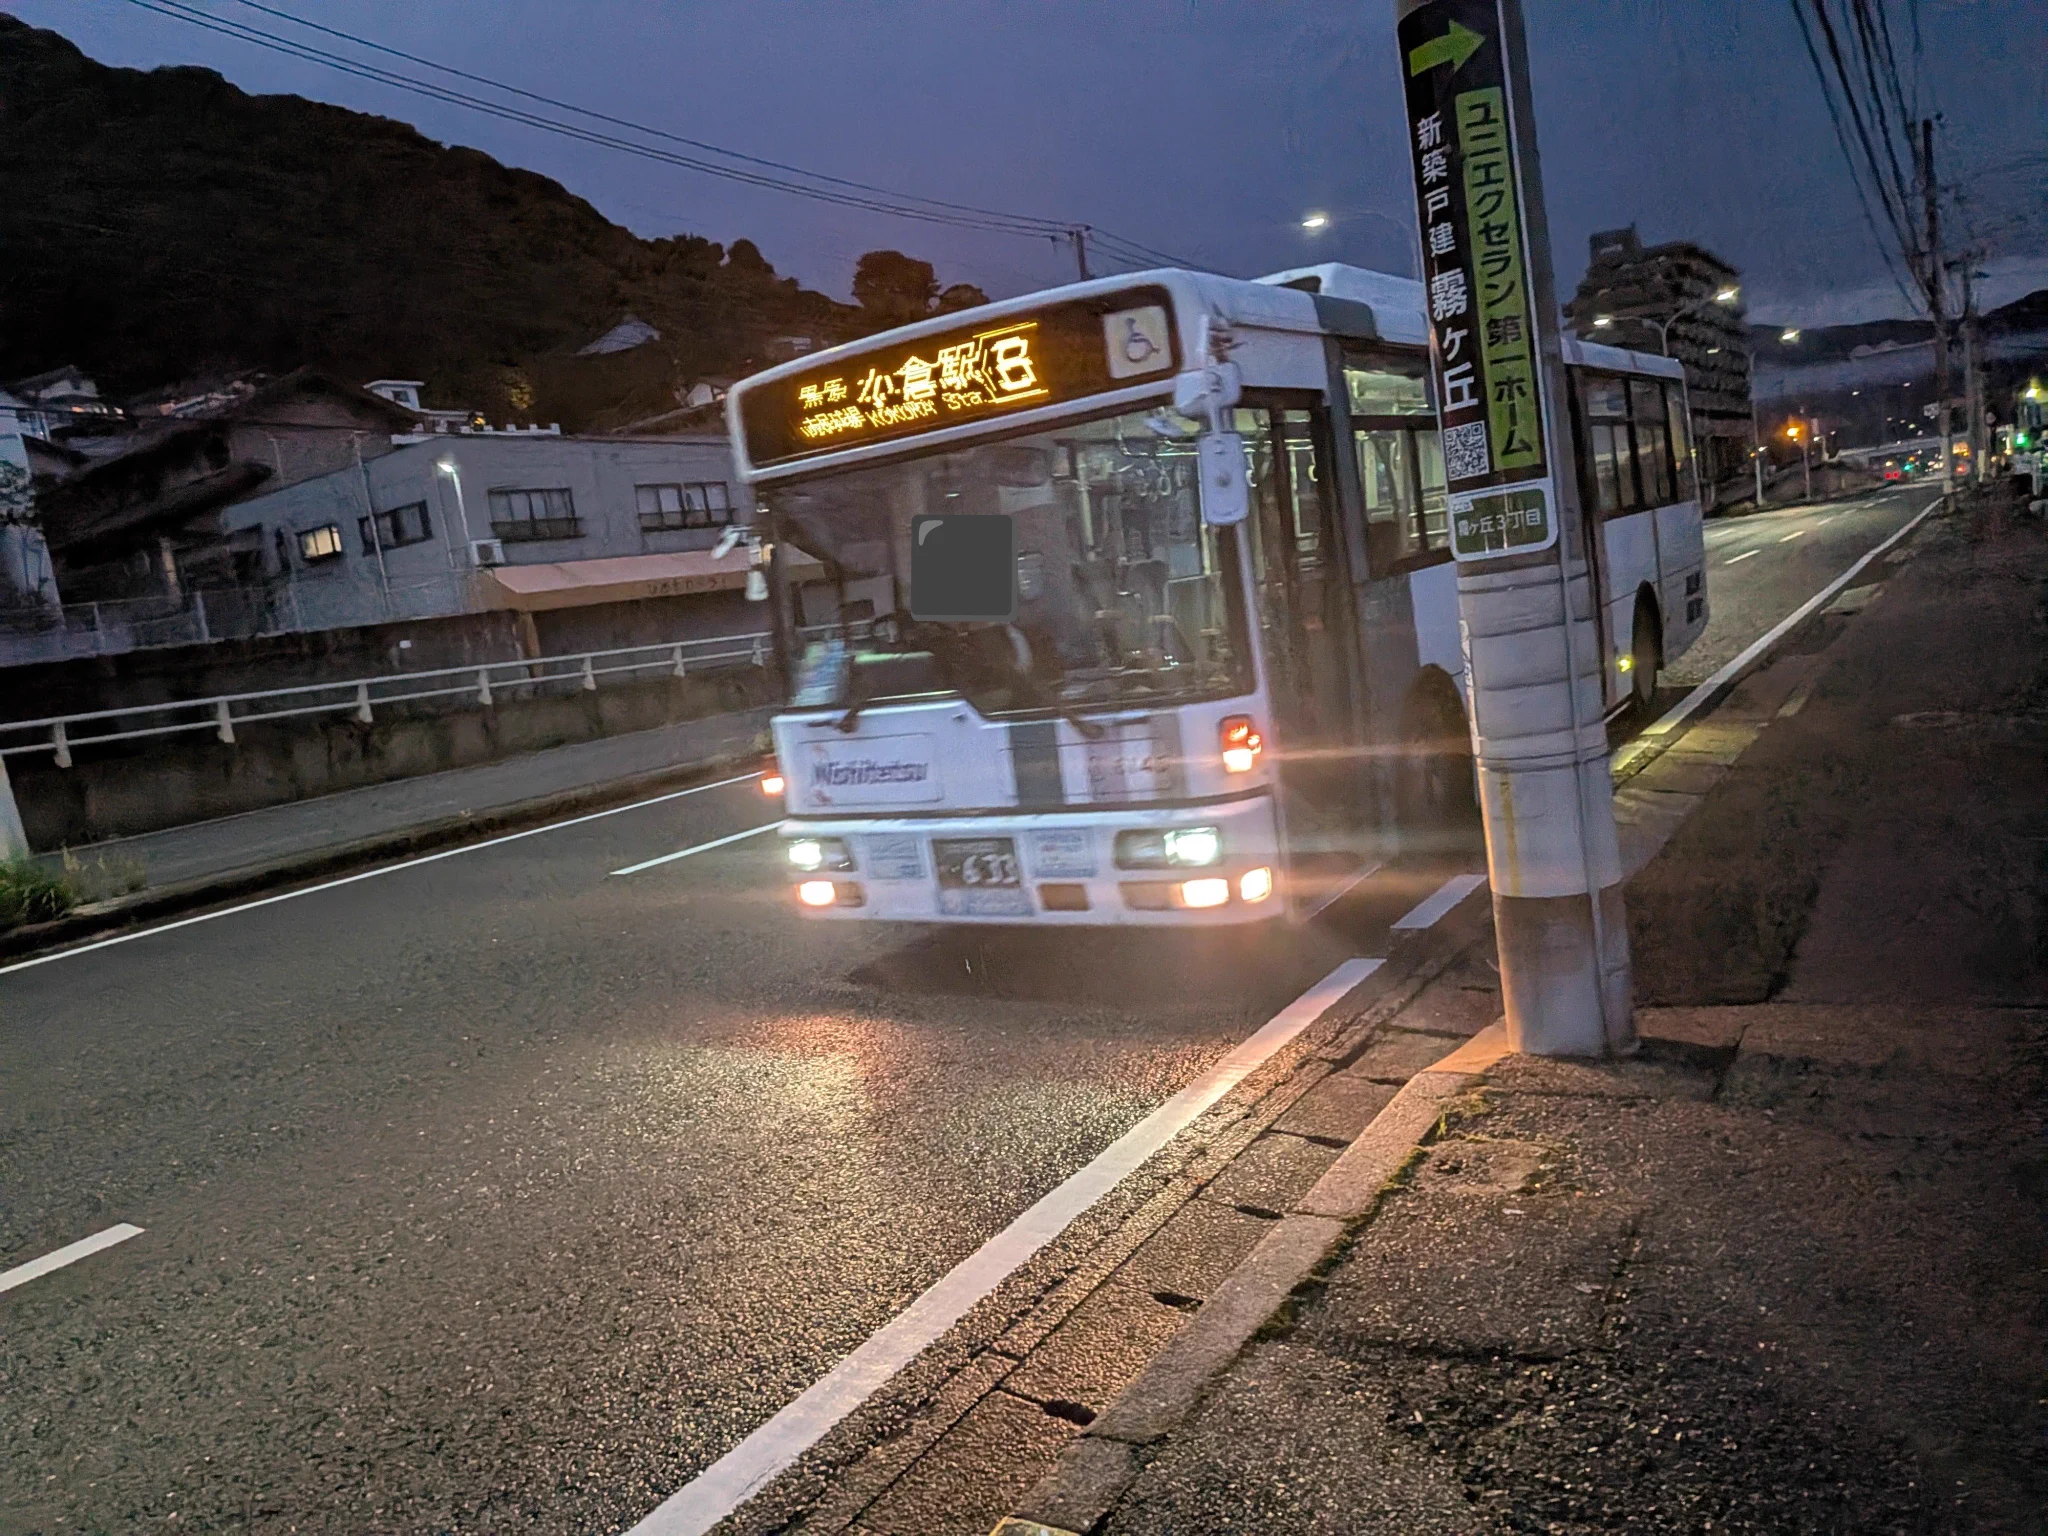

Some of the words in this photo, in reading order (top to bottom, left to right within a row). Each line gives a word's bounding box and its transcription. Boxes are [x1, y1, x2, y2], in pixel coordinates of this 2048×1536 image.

[1464, 101, 1534, 457] ユニエクセラン第一ホーム
[798, 377, 848, 410] 黒原
[857, 340, 985, 409] 小倉駅
[864, 398, 938, 428] KOKURA
